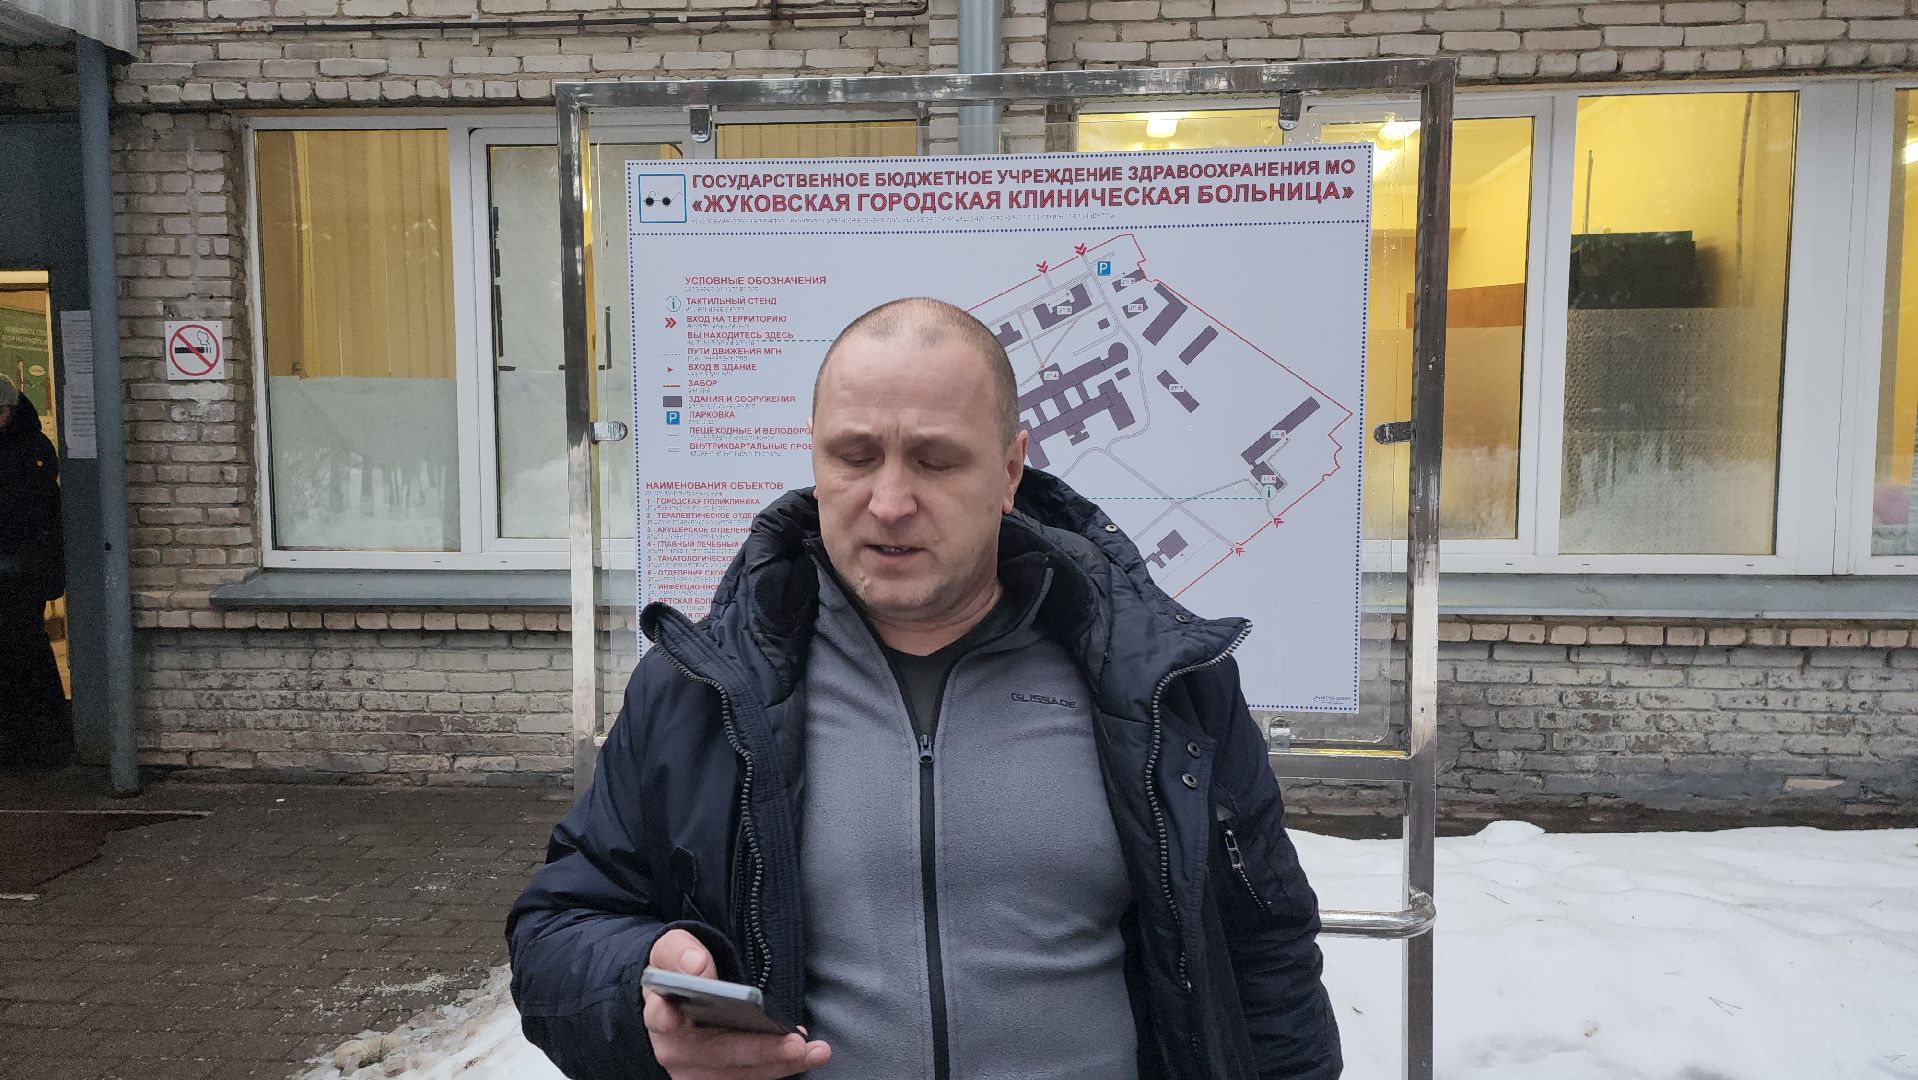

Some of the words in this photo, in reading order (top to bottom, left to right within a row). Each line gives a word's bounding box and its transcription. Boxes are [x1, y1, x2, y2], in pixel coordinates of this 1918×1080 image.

[693, 171, 869, 190] ГОСУДАРСТВЕННОЕ
[876, 169, 992, 188] БЮДЖЕТНОЕ
[998, 167, 1123, 185] УЧРЕЖДЕНИЕ
[1128, 163, 1320, 182] ЗДРАВООХРАНЕНИЯ
[1326, 159, 1355, 175] МО
[692, 193, 850, 213] «ЖУКОВСКАЯ
[858, 190, 1001, 213] ГОРОДСКАЯ
[1008, 186, 1190, 209] КЛИНИЧЕСКАЯ
[1198, 181, 1354, 204] БОЛЬНИЦА»
[685, 276, 745, 285] УСЛОВНЫЕ
[747, 276, 827, 285] ОБОЗНАЧЕНИЯ
[686, 297, 746, 305] ТАКТИЛЬНЫЙ
[748, 297, 777, 305] СТЕНД
[686, 315, 710, 323] ВХОД
[713, 315, 724, 323] НА
[727, 315, 787, 323] ТЕРРИТОРИЮ
[687, 331, 702, 339] ВЫ
[703, 331, 762, 340] НАХОДИТЕСЬ
[765, 331, 794, 340] ЗДЕСЬ
[688, 347, 709, 355] ПУТИ
[712, 347, 761, 355] ДВИЖЕНИЯ
[763, 347, 782, 355] МГН
[688, 363, 711, 371] ВХОД
[713, 363, 719, 371] В
[722, 363, 757, 371] ЗДАНИЕ
[688, 379, 718, 387] ЗАБОР
[688, 395, 724, 403] ЗДАНИЯ
[734, 395, 796, 403] СООРУЖЕНИЯ
[689, 427, 753, 435] ПЕШЕХОДНЫЕ
[689, 442, 788, 450] ВНУТРИКВАРТАЛЬНЫЕ
[646, 481, 727, 490] НАИМЕНОВАНИЯ
[730, 481, 784, 490] ОБЪЕКТОВ
[1010, 692, 1077, 709] GLISSADE
